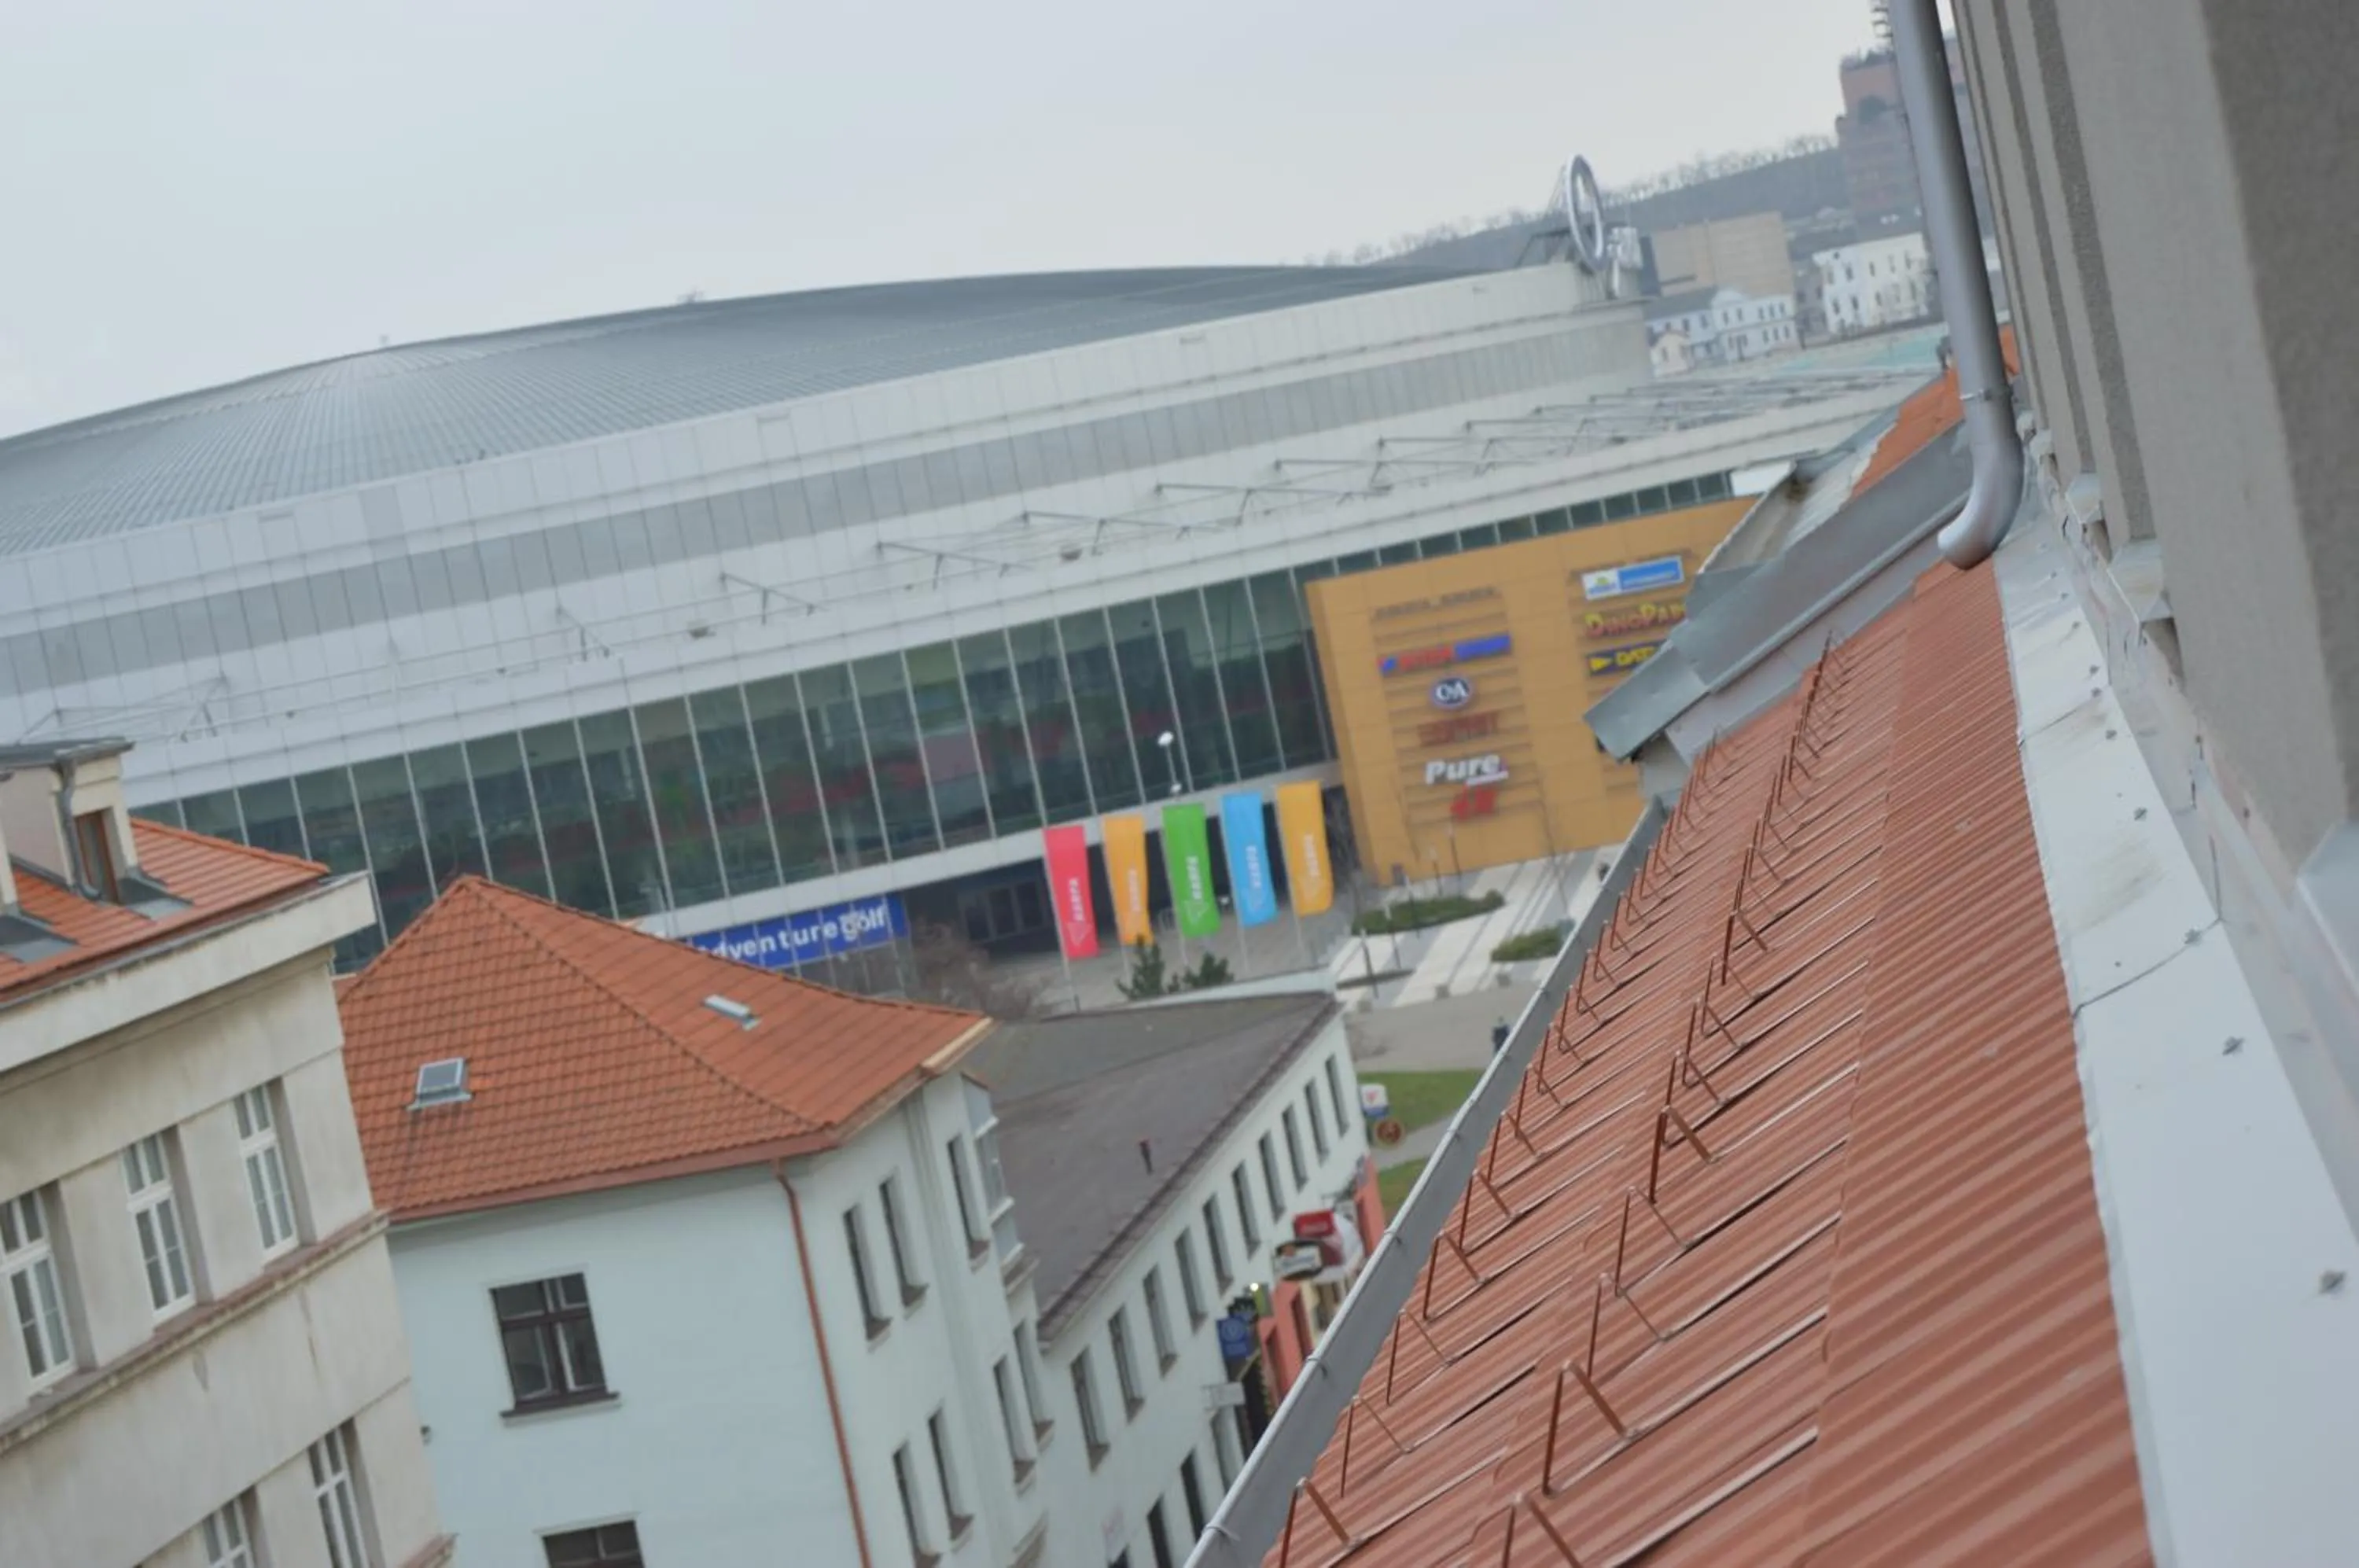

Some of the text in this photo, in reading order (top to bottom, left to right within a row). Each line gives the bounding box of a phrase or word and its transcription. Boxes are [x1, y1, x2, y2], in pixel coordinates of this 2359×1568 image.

[1425, 754, 1500, 785] Pure
[697, 904, 886, 960] dventure golf
